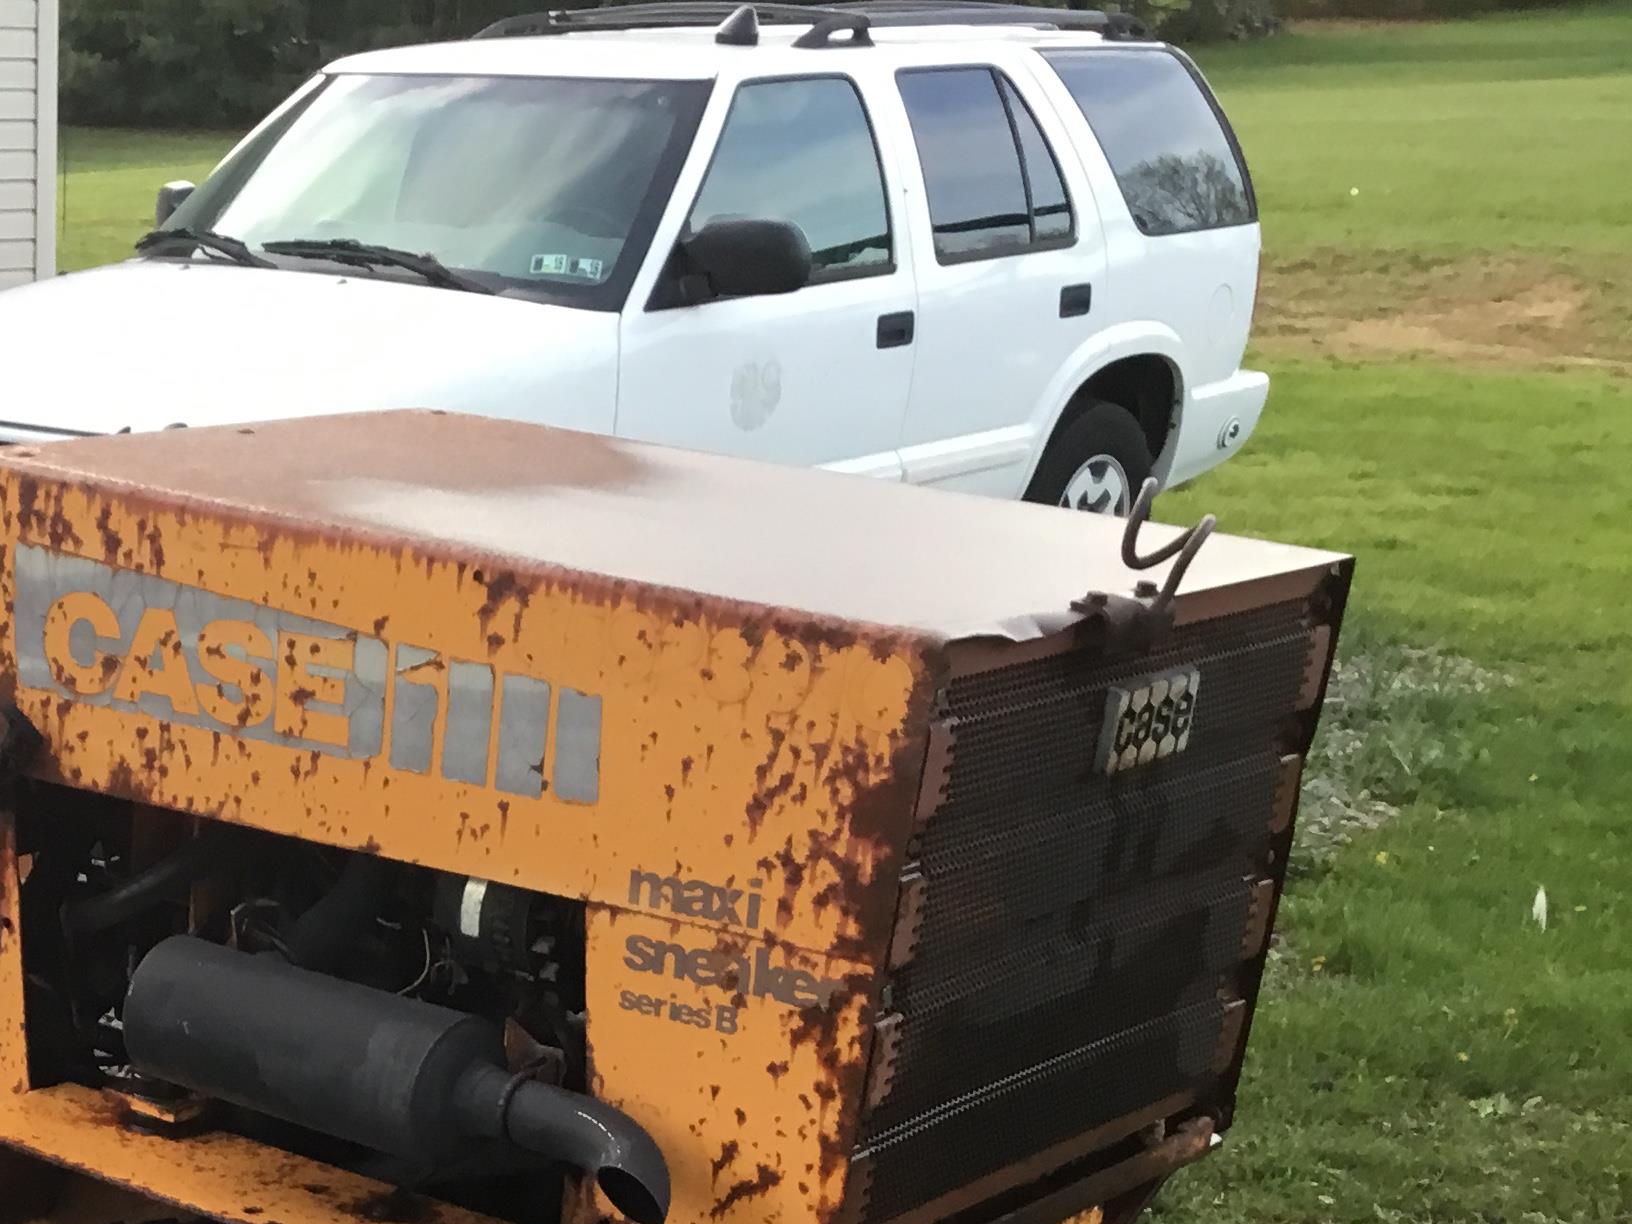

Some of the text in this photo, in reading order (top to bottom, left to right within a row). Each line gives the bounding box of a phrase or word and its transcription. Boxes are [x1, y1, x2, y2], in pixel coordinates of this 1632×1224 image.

[43, 591, 355, 747] CASE
[627, 868, 763, 930] maxi
[618, 989, 712, 1030] series
